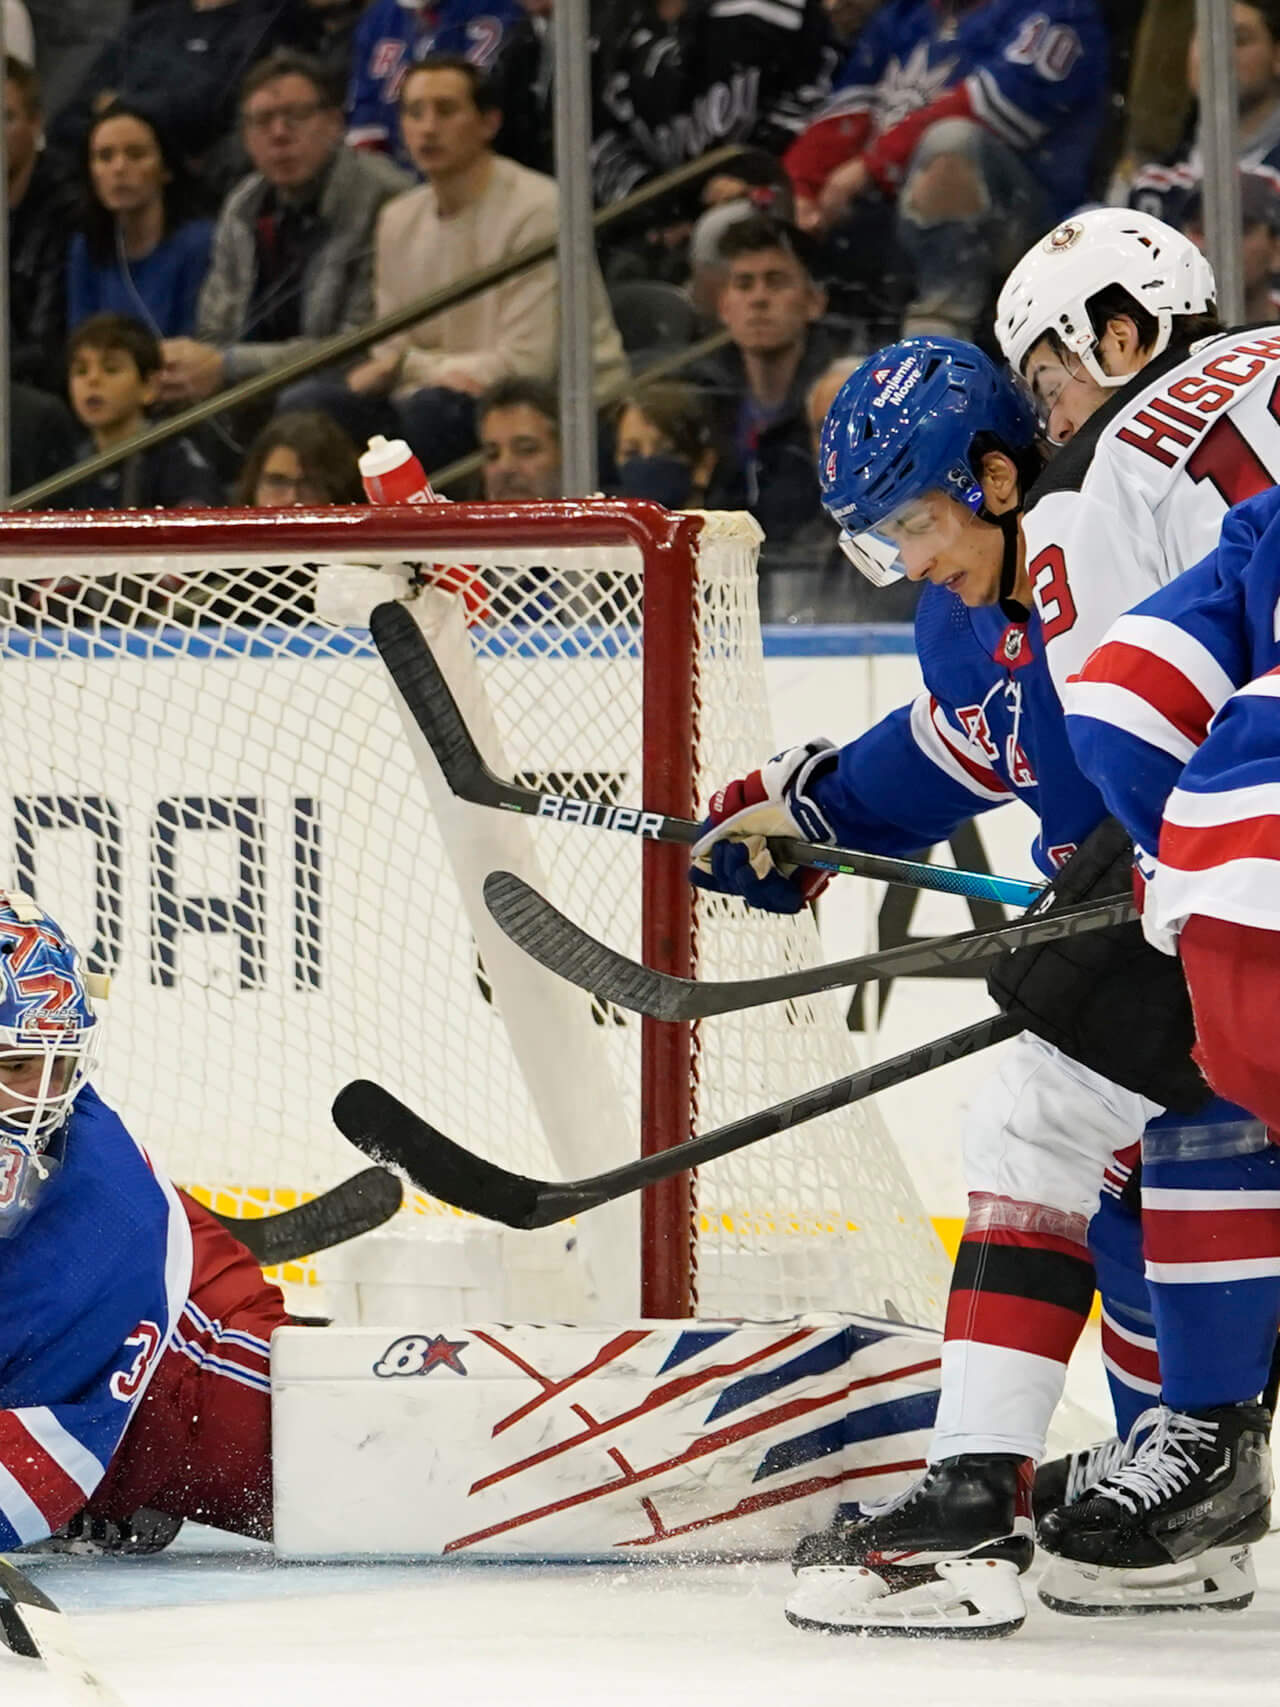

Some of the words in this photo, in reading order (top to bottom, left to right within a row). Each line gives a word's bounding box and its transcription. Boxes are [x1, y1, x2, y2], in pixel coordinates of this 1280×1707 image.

[1003, 12, 1084, 81] 10
[872, 356, 917, 408] Benjamin
[889, 368, 922, 406] Moore
[536, 794, 665, 840] BAUER
